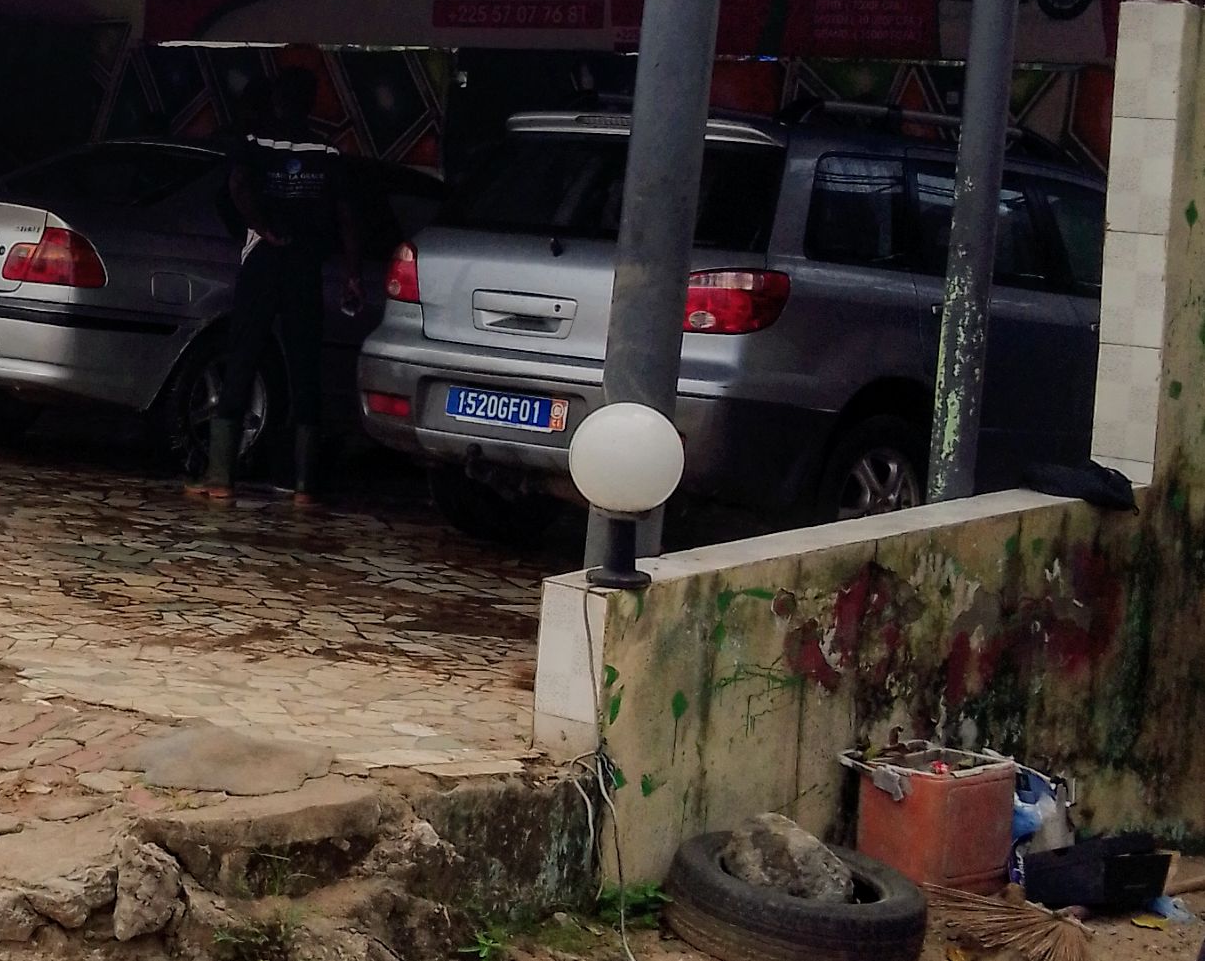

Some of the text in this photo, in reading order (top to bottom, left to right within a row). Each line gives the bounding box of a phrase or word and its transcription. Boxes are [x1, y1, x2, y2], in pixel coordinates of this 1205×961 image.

[448, 4, 587, 23] +225 57 07 76 81
[457, 390, 541, 425] 1520GF01
